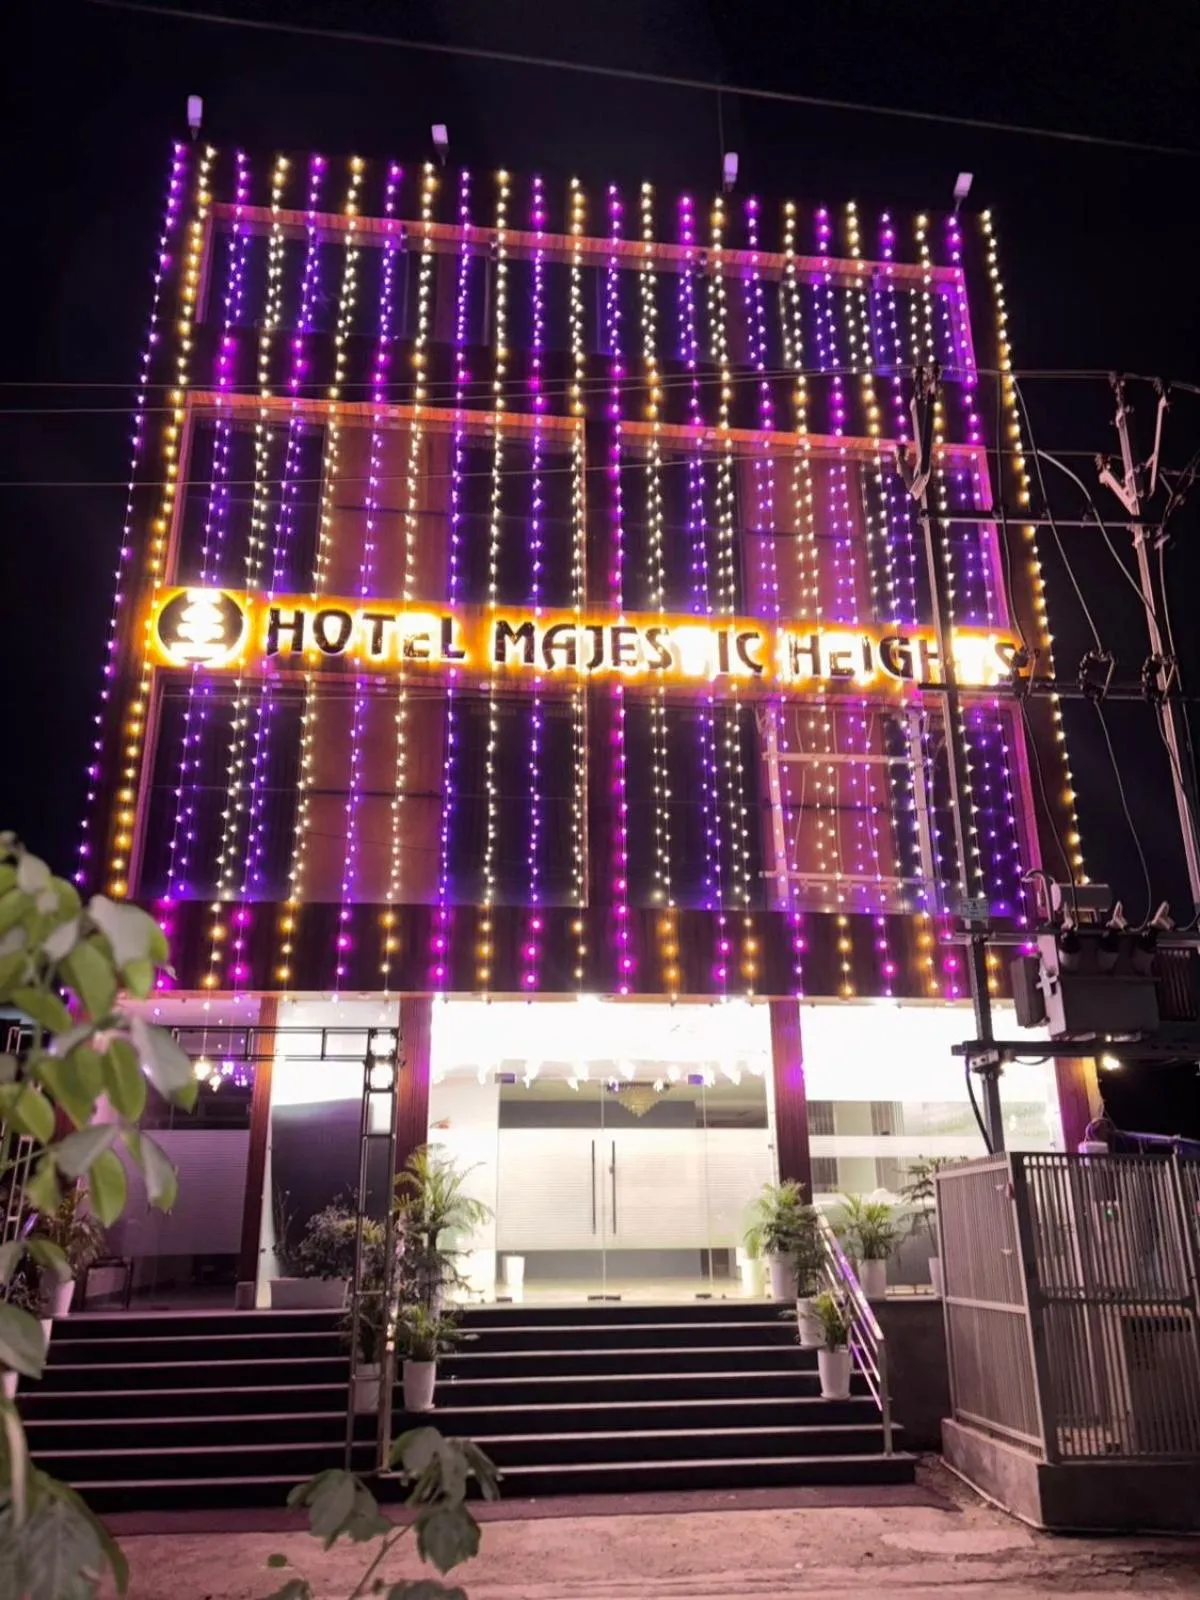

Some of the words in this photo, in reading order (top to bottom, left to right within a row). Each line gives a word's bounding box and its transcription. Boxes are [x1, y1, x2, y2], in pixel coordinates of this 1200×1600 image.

[267, 607, 466, 660] HOTEL
[494, 619, 764, 675] MAJESIC
[788, 633, 1022, 684] HEIGHS
